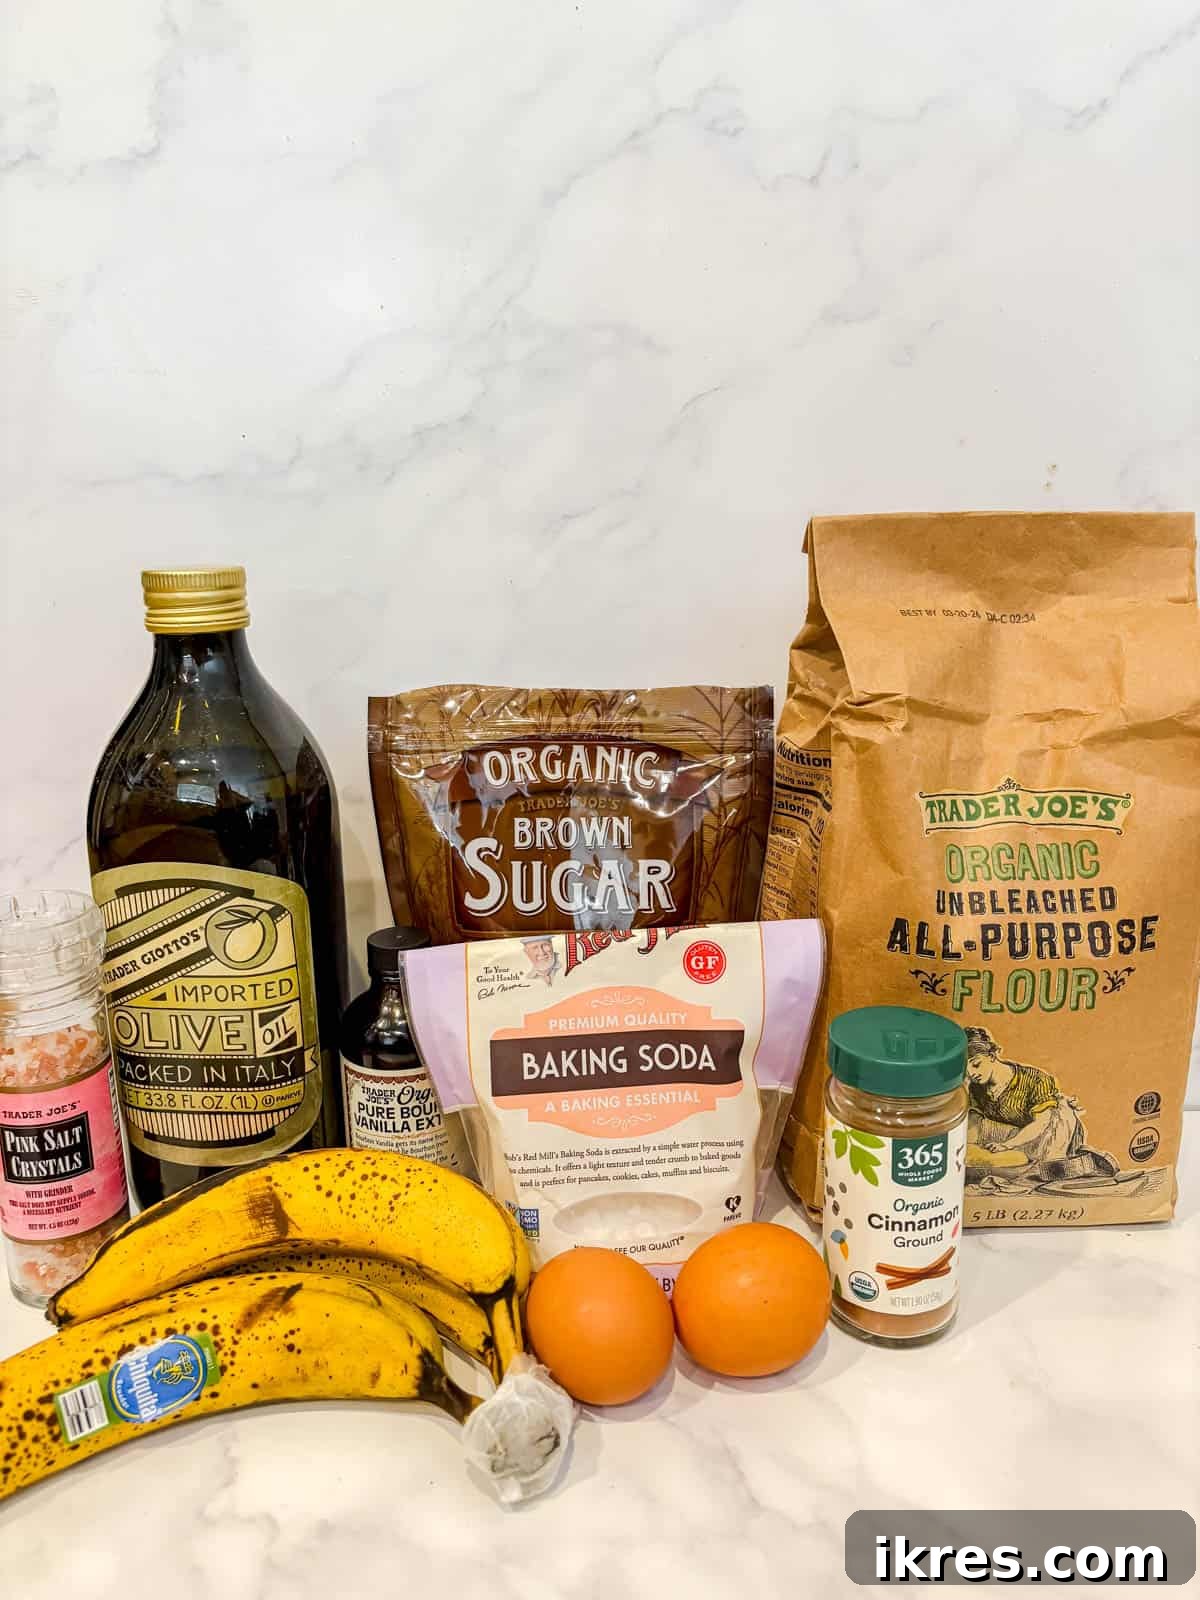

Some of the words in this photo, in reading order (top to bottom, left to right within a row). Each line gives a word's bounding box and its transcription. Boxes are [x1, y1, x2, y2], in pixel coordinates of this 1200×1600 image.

[899, 608, 922, 617] BEST
[483, 743, 660, 789] ORGANIC
[776, 740, 832, 769] Nutrition
[924, 793, 1022, 824] TRADER
[513, 816, 633, 850] BROWN
[945, 839, 1100, 883] ORGANIC
[463, 836, 676, 917] SUGAR
[935, 886, 1118, 916] UNBLEACHED
[141, 929, 201, 965] GIOTTO'S
[887, 915, 1160, 961] ALL-PURPOSE
[690, 955, 720, 970] GF
[174, 977, 294, 1003] IMPORTED
[476, 974, 495, 984] Good
[951, 967, 1099, 1014] FLOUR
[112, 1008, 247, 1052] OLIVE
[262, 1018, 296, 1046] OIL
[548, 1014, 619, 1031] PREMIUM
[624, 1011, 688, 1028] QUALITY
[203, 1063, 227, 1084] IN
[235, 1055, 296, 1083] ITALY
[522, 1045, 628, 1081] BAKING
[638, 1042, 717, 1072] SODA
[144, 1092, 177, 1109] 33.8
[230, 1093, 258, 1110] (1L)
[360, 1085, 396, 1098] TRADER
[396, 1085, 434, 1106] Org
[545, 1100, 557, 1113] A
[560, 1096, 621, 1113] BAKING
[626, 1089, 700, 1106] ESSENTIAL
[2, 1110, 42, 1119] TRADER
[354, 1111, 411, 1133] VANILLA
[358, 1101, 396, 1120] PURE
[3, 1129, 41, 1153] PINK
[43, 1125, 83, 1153] SALT
[523, 1152, 537, 1161] Red
[539, 1150, 559, 1161] Mill's
[560, 1149, 585, 1160] Baking
[585, 1147, 603, 1157] Soda
[604, 1147, 610, 1156] is
[611, 1144, 641, 1155] extracted
[642, 1143, 651, 1154] by
[657, 1140, 680, 1152] simple
[681, 1140, 700, 1149] water
[700, 1140, 725, 1150] process
[726, 1138, 744, 1149] using
[11, 1151, 83, 1178] CRYSTALS
[555, 1163, 561, 1173] It
[562, 1162, 582, 1173] offers
[588, 1160, 605, 1172] light
[606, 1160, 630, 1169] texture
[631, 1157, 644, 1167] and
[645, 1156, 666, 1166] tender
[667, 1153, 690, 1164] crumb
[699, 1151, 720, 1161] baked
[721, 1150, 741, 1162] goods
[897, 1142, 944, 1169] 365
[519, 1179, 533, 1188] and
[534, 1178, 540, 1187] is
[541, 1176, 565, 1189] perfect
[566, 1175, 576, 1185] for
[578, 1173, 611, 1185] pancakes,
[612, 1171, 640, 1182] cookies,
[640, 1170, 661, 1180] cakes,
[662, 1166, 688, 1178] muffins
[689, 1165, 702, 1175] and
[703, 1163, 730, 1174] biscuits.
[897, 1170, 922, 1178] WHOLE
[923, 1166, 943, 1176] FOODS
[907, 1174, 935, 1183] MARKET
[25, 1189, 43, 1200] WITH
[43, 1184, 74, 1199] GRINDER
[867, 1204, 960, 1232] Cinnamon
[893, 1196, 944, 1216] Organic
[970, 1211, 981, 1223] 5
[984, 1207, 1007, 1220] LB
[1012, 1208, 1054, 1222] (2.27
[1058, 1206, 1086, 1223] kg)
[629, 1245, 647, 1254] OUR
[893, 1230, 944, 1248] Ground
[126, 1353, 162, 1423] Chiquita
